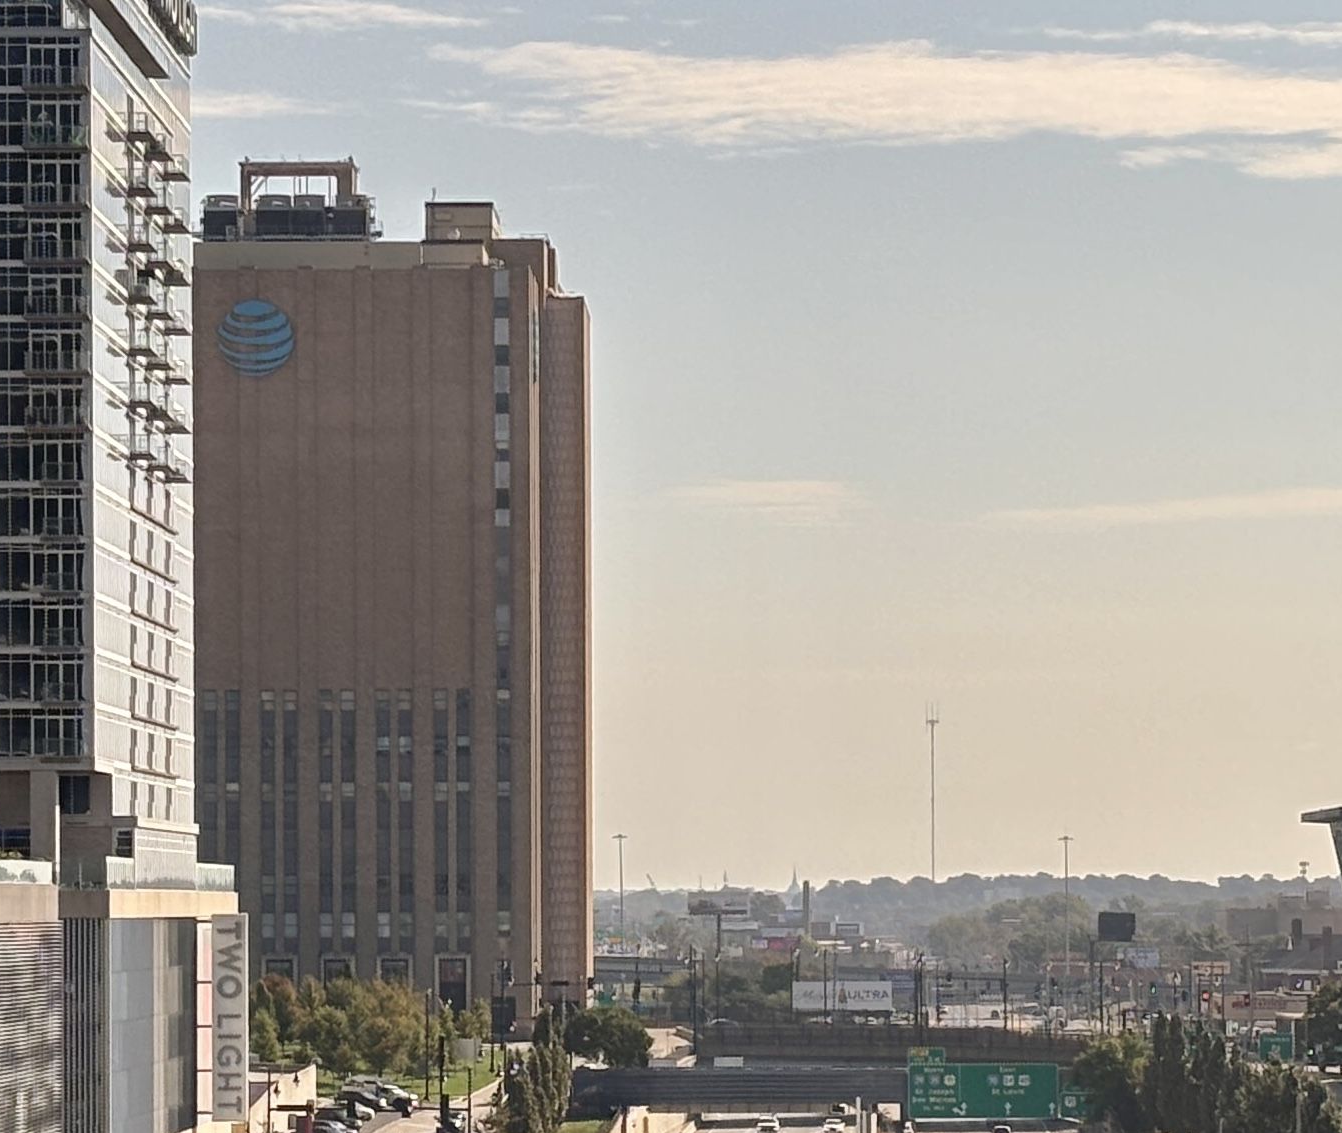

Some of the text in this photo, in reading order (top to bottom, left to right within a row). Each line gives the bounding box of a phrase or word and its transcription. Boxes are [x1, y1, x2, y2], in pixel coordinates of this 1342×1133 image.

[217, 921, 242, 1114] TWO LIGHT
[847, 990, 889, 1000] ULTRA
